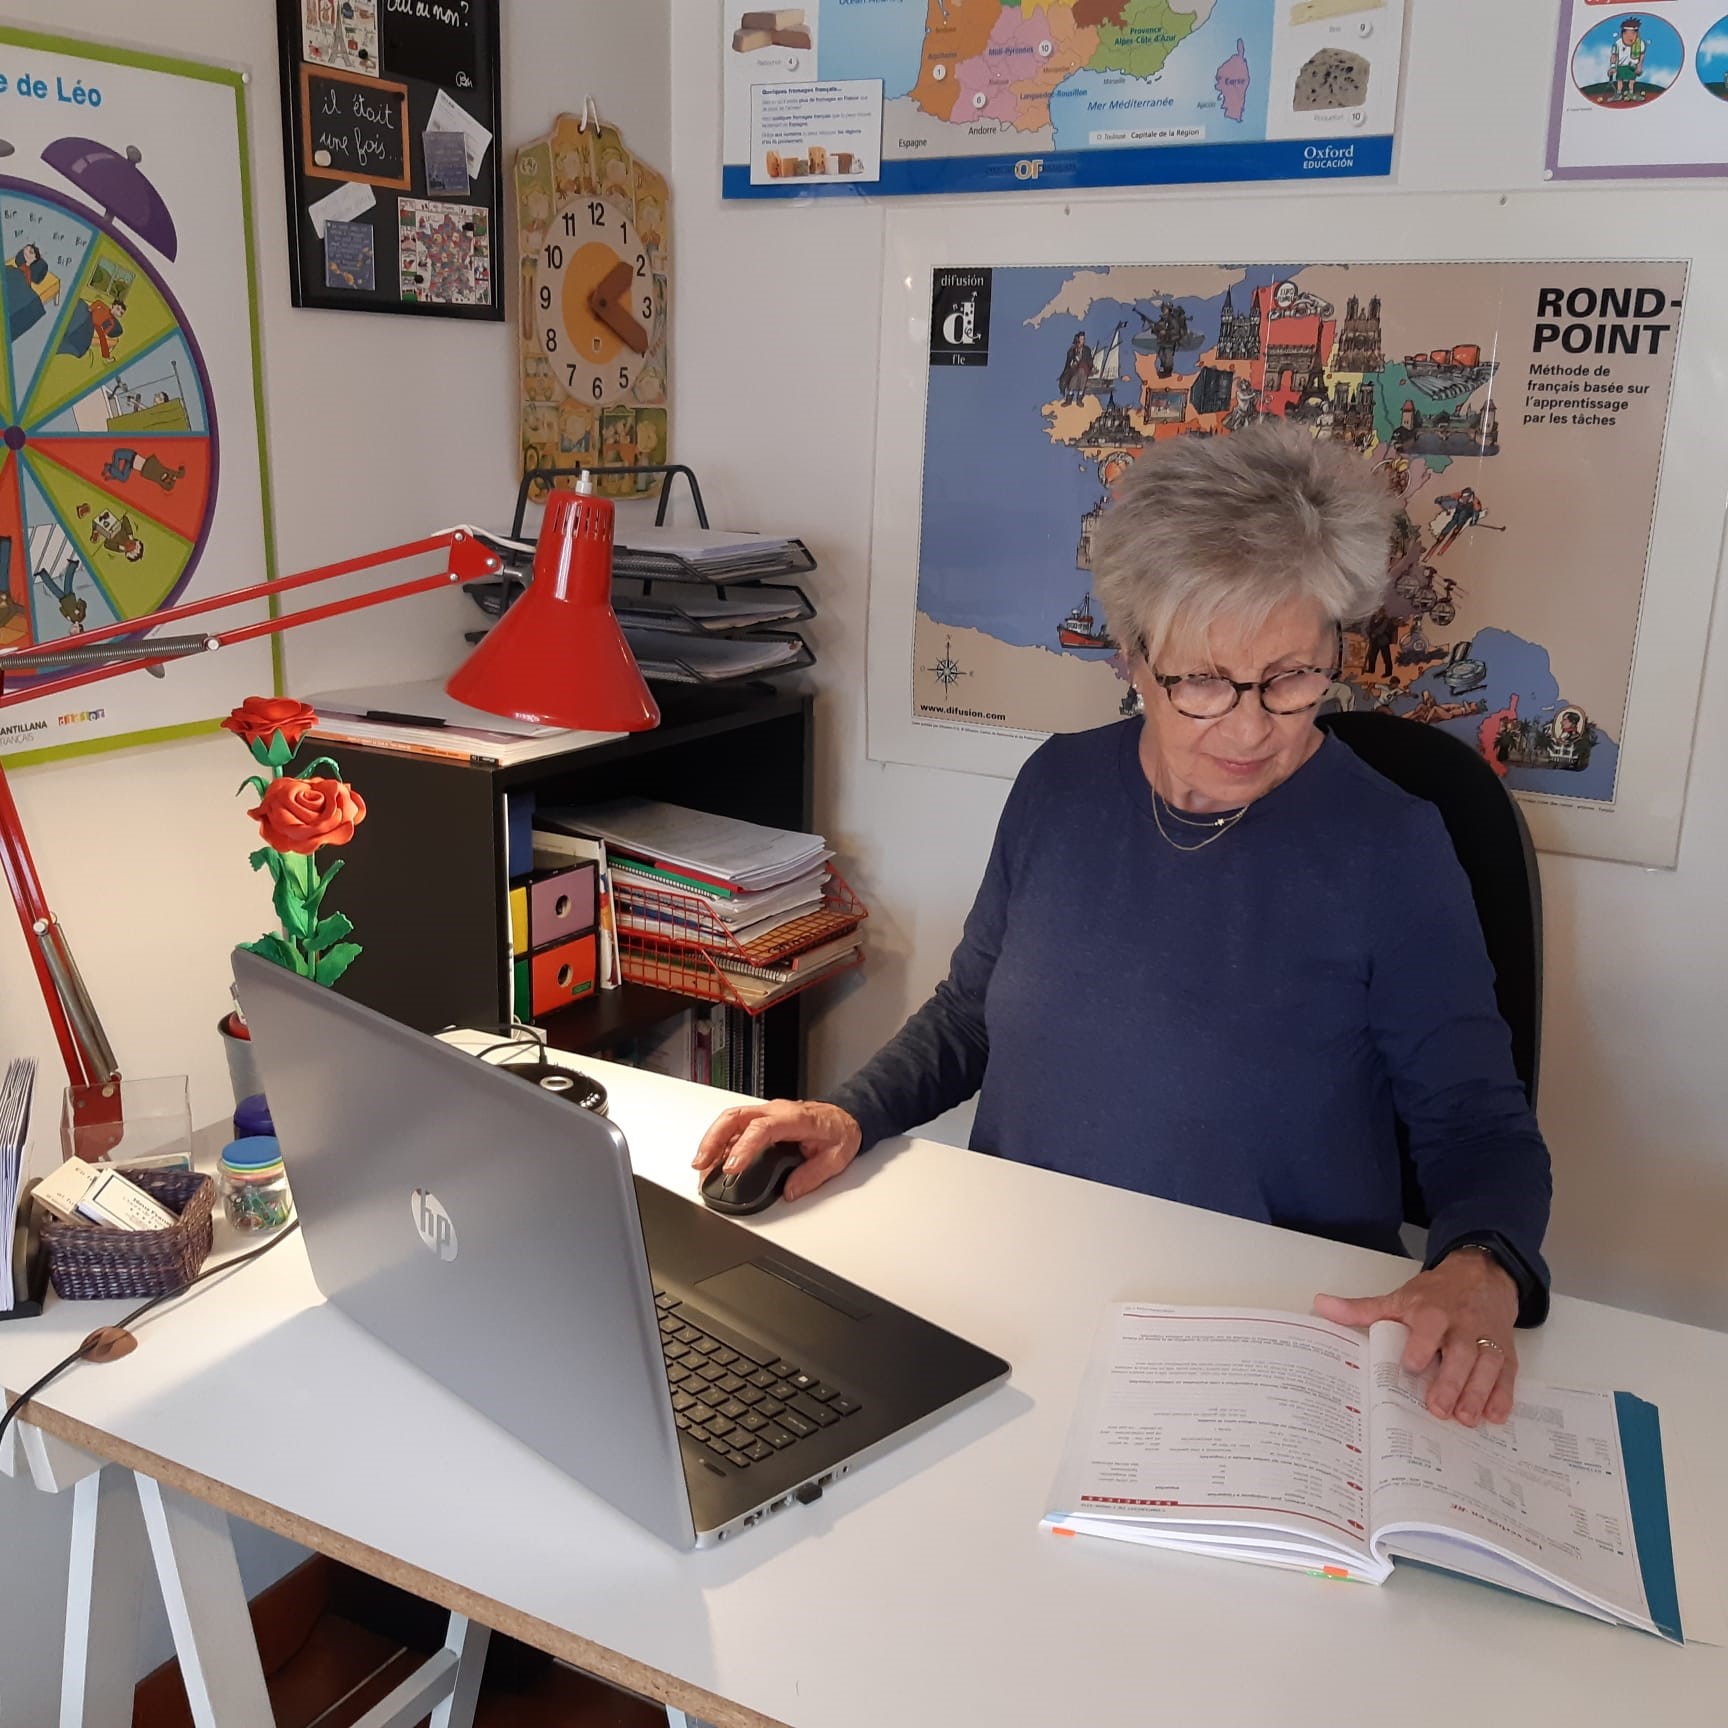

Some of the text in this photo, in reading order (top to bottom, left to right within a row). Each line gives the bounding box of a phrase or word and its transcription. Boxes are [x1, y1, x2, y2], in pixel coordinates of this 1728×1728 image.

[1130, 26, 1162, 35] Provence
[1360, 23, 1366, 32] 9
[1041, 44, 1049, 53] 10
[17, 73, 48, 99] de
[57, 76, 102, 107] Léo
[1224, 77, 1246, 85] Corse
[321, 89, 395, 129] il était
[1087, 97, 1174, 111] Mer Méditerranée
[1352, 112, 1361, 120] 10
[968, 125, 997, 136] Andorre
[1130, 130, 1158, 139] Capitale
[1168, 129, 1175, 137] la
[1176, 128, 1200, 138] Région
[319, 131, 350, 157] une
[898, 138, 928, 149] Espagne
[1303, 144, 1354, 159] Oxford
[1303, 158, 1354, 169] EDUCACIÓN
[587, 200, 605, 227] 12
[561, 211, 576, 237] 11
[620, 221, 627, 245] 1
[543, 244, 563, 269] 10
[635, 254, 646, 277] 2
[940, 273, 984, 287] difusión
[539, 285, 551, 310] 9
[641, 296, 652, 319] 3
[1536, 287, 1683, 318] ROND-
[545, 328, 557, 352] 8
[1532, 323, 1671, 354] POINT
[566, 363, 577, 387] 7
[618, 366, 630, 389] 5
[1529, 363, 1611, 377] Méthode de
[592, 376, 603, 400] 6
[1527, 380, 1650, 395] français basée sur
[1525, 396, 1629, 412] l'apprentissage
[1523, 413, 1616, 426] par les tâches
[919, 703, 1006, 721] www.difusion.com
[411, 1188, 459, 1263] hp
